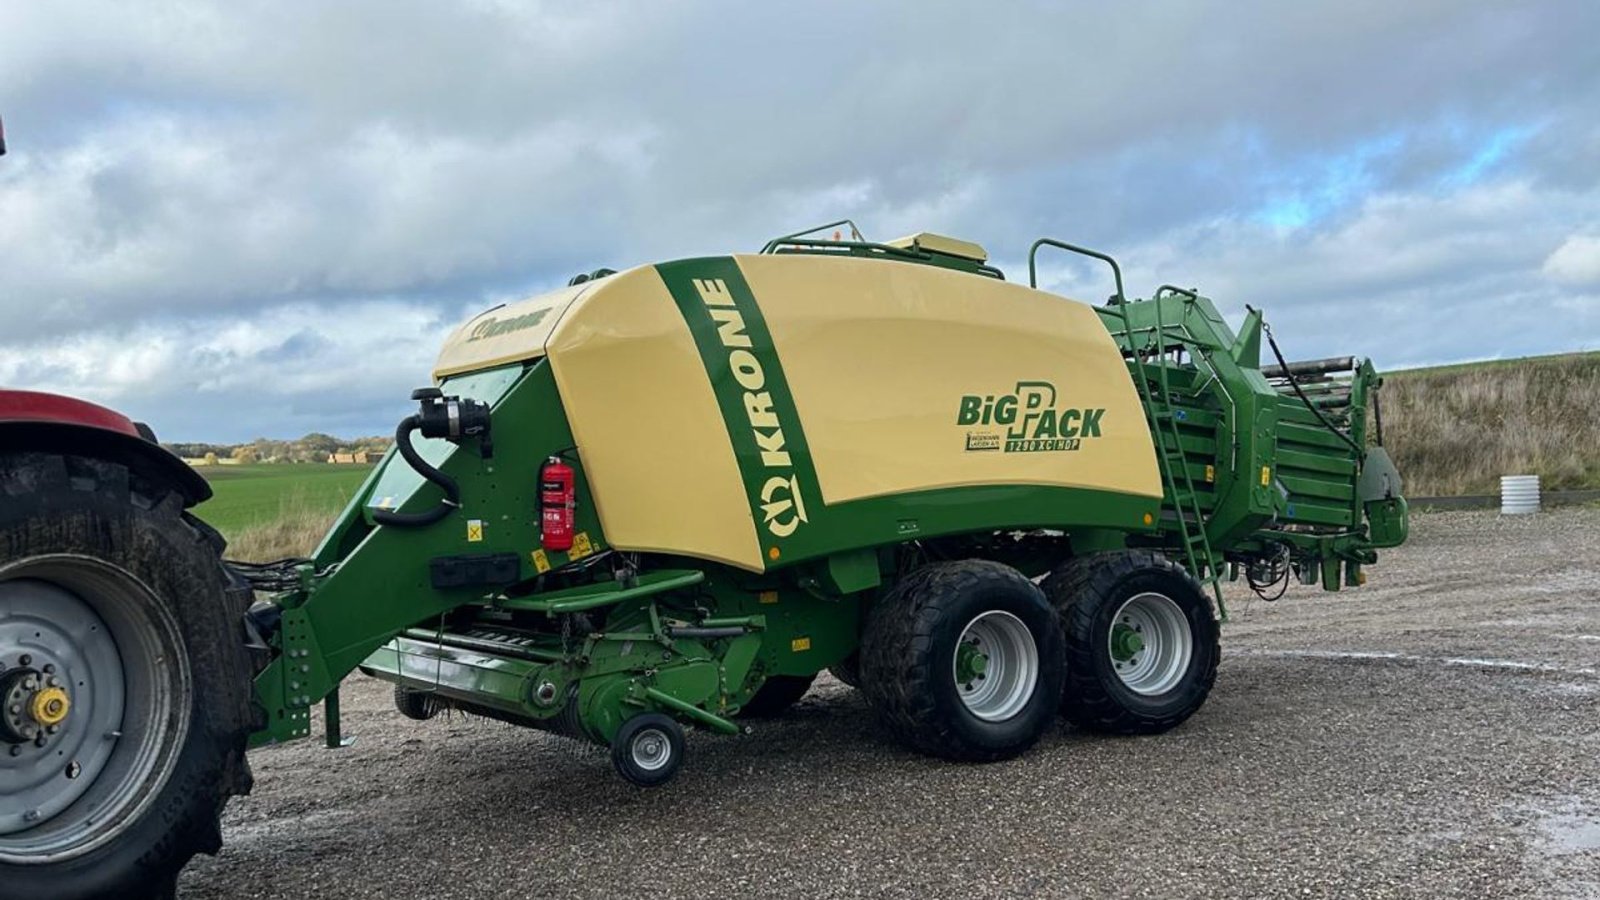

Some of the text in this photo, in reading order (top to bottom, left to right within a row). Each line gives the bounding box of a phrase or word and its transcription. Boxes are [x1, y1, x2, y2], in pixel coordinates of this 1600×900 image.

[691, 278, 793, 467] KRONE
[1007, 381, 1106, 439] PACK
[1010, 441, 1036, 451] 1290
[1057, 439, 1079, 450] HDP
